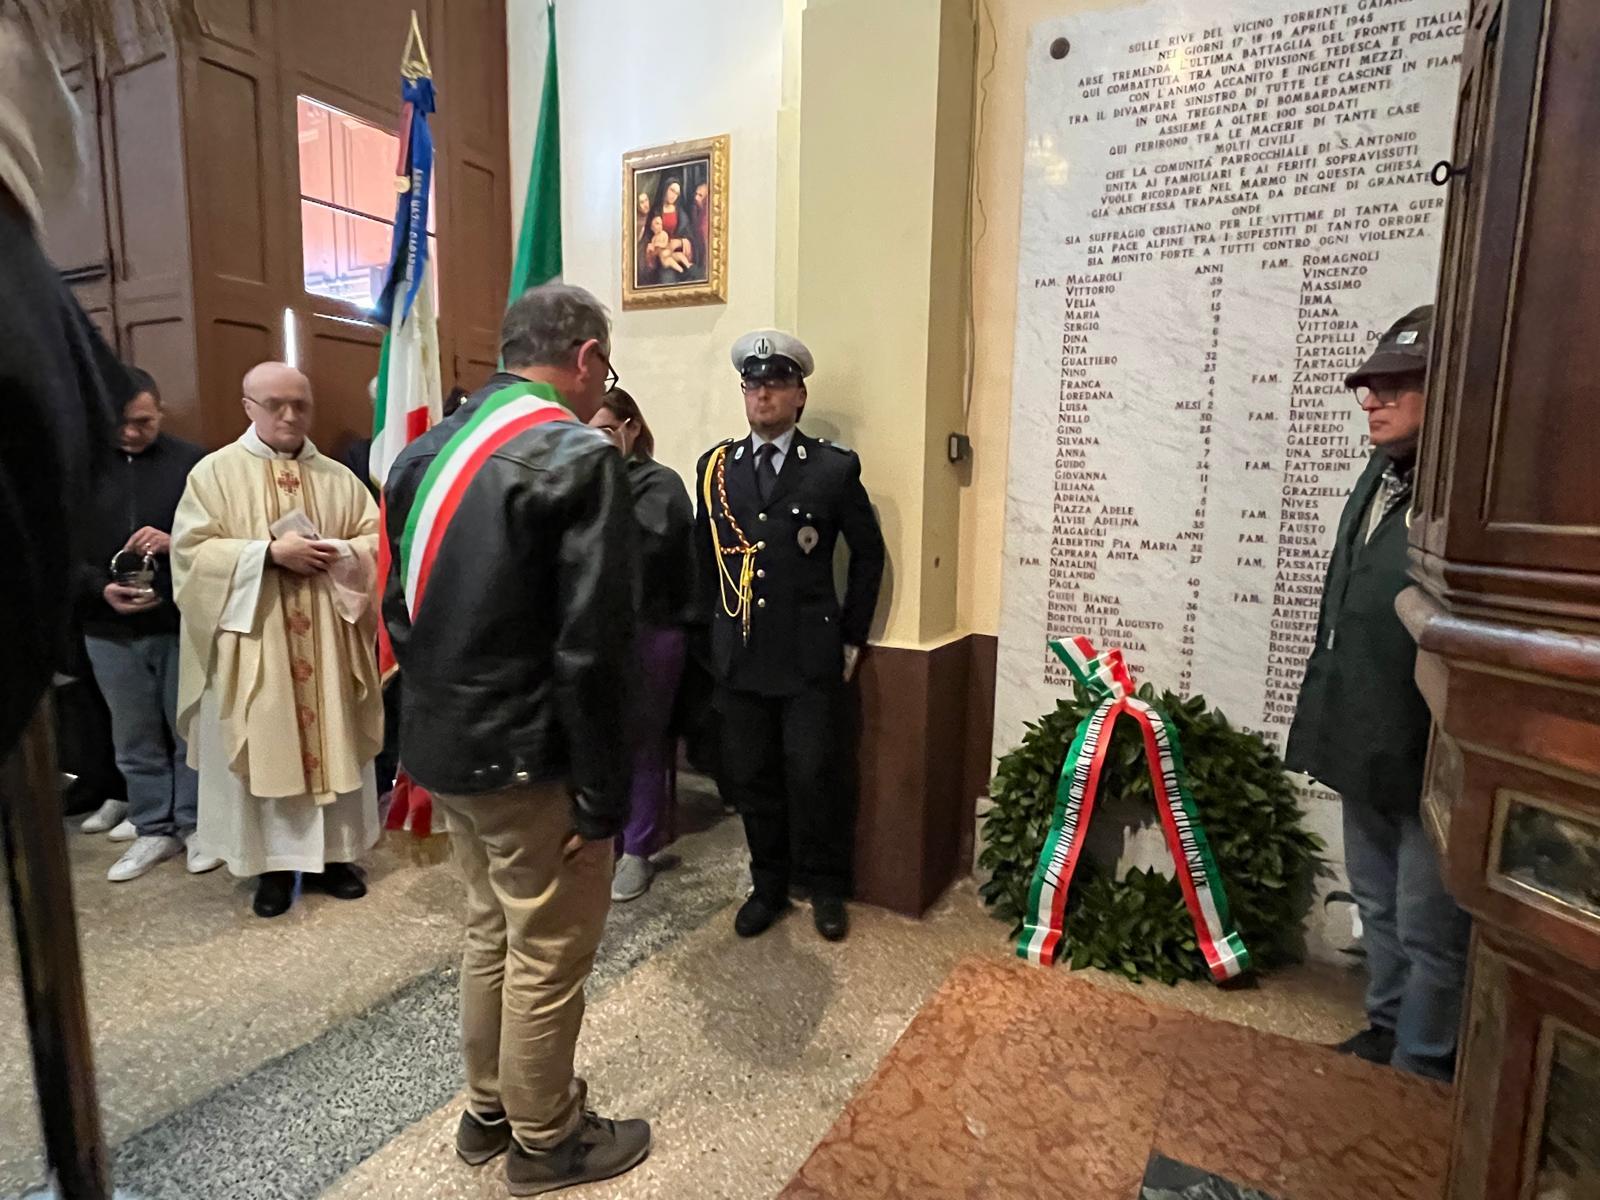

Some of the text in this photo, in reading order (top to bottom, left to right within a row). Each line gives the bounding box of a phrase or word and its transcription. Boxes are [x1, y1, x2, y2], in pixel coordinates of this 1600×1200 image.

[1128, 1, 1348, 53] SULLE RIVE DEL VICINO TORRENTE
[1185, 13, 1373, 55] GIORNI APRILE 1945
[1078, 74, 1103, 87] ARSE
[1112, 64, 1170, 82] TREMENDA
[1242, 39, 1312, 59] BATTAGLIA
[1322, 32, 1344, 44] DEL
[1354, 21, 1406, 39] FRONTE
[1083, 40, 1380, 98] QUI COMBATTUTA TRA UNA DIVISIONE TEDESCA
[1129, 91, 1149, 102] CON
[1214, 71, 1273, 89] ACCANITO
[1298, 57, 1350, 74] INGENTI
[1069, 62, 1416, 125] TRA IL DIVAMPARE SINISTRO DI TUTTE LE CASCINE IN
[1136, 80, 1391, 126] IN UNA TREGENDA DI BOMBARDAMENTI
[1159, 98, 1358, 136] ASSIEME OLTRE 100 SOLDATI
[1109, 102, 1420, 156] QUI PERIRONO TRA LE MACERIE DI TANTE CASE
[1215, 134, 1295, 153] MOLTI CIVILI
[1106, 131, 1416, 180] CHE LA PARROCCHIALE DI ANTONIO
[1106, 145, 1418, 193] UNITA AI FAMIGLIARI AI FERITI SOPRAVISSUTI
[1101, 160, 1421, 205] VUOLE RICORDARE NEL MARMO IN QUESTA CHIESA
[1185, 182, 1336, 208] TRAPASSATA DECINE
[1232, 205, 1261, 216] ONDE
[1065, 204, 1398, 245] SIA SUFFRAGIO CRISTIANO PER VITTIME TANTA
[1088, 213, 1431, 254] SIA PACE ALFINE TRA SUPESTITI TANTO ORRORE
[1088, 236, 1349, 266] SIA MONITO FORTE TUTTI CONTRO OGNI
[1303, 252, 1379, 266] ROMAGNOLI
[1303, 267, 1367, 278] VINCENZO
[1067, 273, 1122, 285] MAGAROLI
[1066, 286, 1115, 296] VITTORIO
[1300, 280, 1361, 292] MASSIMO
[1066, 299, 1096, 308] VELIA
[1065, 311, 1100, 320] MARIA
[1299, 308, 1339, 318] DIANA
[1064, 323, 1099, 331] SERGIO
[1298, 321, 1358, 331] VITTORIA
[1296, 333, 1355, 344] CAPPELLI
[1296, 347, 1366, 357] TARTAGLIA
[1062, 357, 1117, 365] GUALTIERO
[1061, 380, 1100, 389] FRANCA
[1060, 391, 1113, 400] LOREDANA
[1059, 402, 1200, 411] LUISA MESI
[1290, 399, 1324, 408] LIVIA
[1058, 414, 1090, 423] NELLO
[1290, 411, 1352, 421] BRUNETTI
[1288, 424, 1344, 433] ALFREDO
[1057, 437, 1099, 445] SILVANA
[1287, 436, 1349, 446] GALEOTTI
[1056, 460, 1085, 468] GUIDO
[1285, 461, 1350, 471] FATTORINI
[1055, 471, 1107, 481] GIOVANNA
[1284, 474, 1319, 483] ITALO
[1054, 481, 1094, 491] LILIANA
[1054, 493, 1100, 503] ADRIANA
[1281, 499, 1318, 509] NIVES
[1053, 504, 1091, 514] PIAZZA
[1101, 506, 1134, 515] ADELE
[1281, 510, 1319, 520] BRUSA
[1053, 516, 1139, 526] ALVISI ADELINA
[1052, 526, 1107, 536] MAGAROLI
[1280, 523, 1326, 533] FAUSTO
[1052, 538, 1177, 551] ALBERTINI MARIA
[1279, 535, 1317, 545] BRUSA
[1050, 548, 1139, 560] CAPRARA ANITA
[1050, 558, 1096, 569] NATALINI
[1049, 569, 1095, 580] ORLANDO
[1049, 579, 1080, 589] PAOLA
[1083, 593, 1120, 604] BIANCA
[1048, 602, 1076, 612] BENNI
[1048, 612, 1164, 630] BORTOLOTTI AUGUSTO
[1100, 628, 1132, 638] DUILIO
